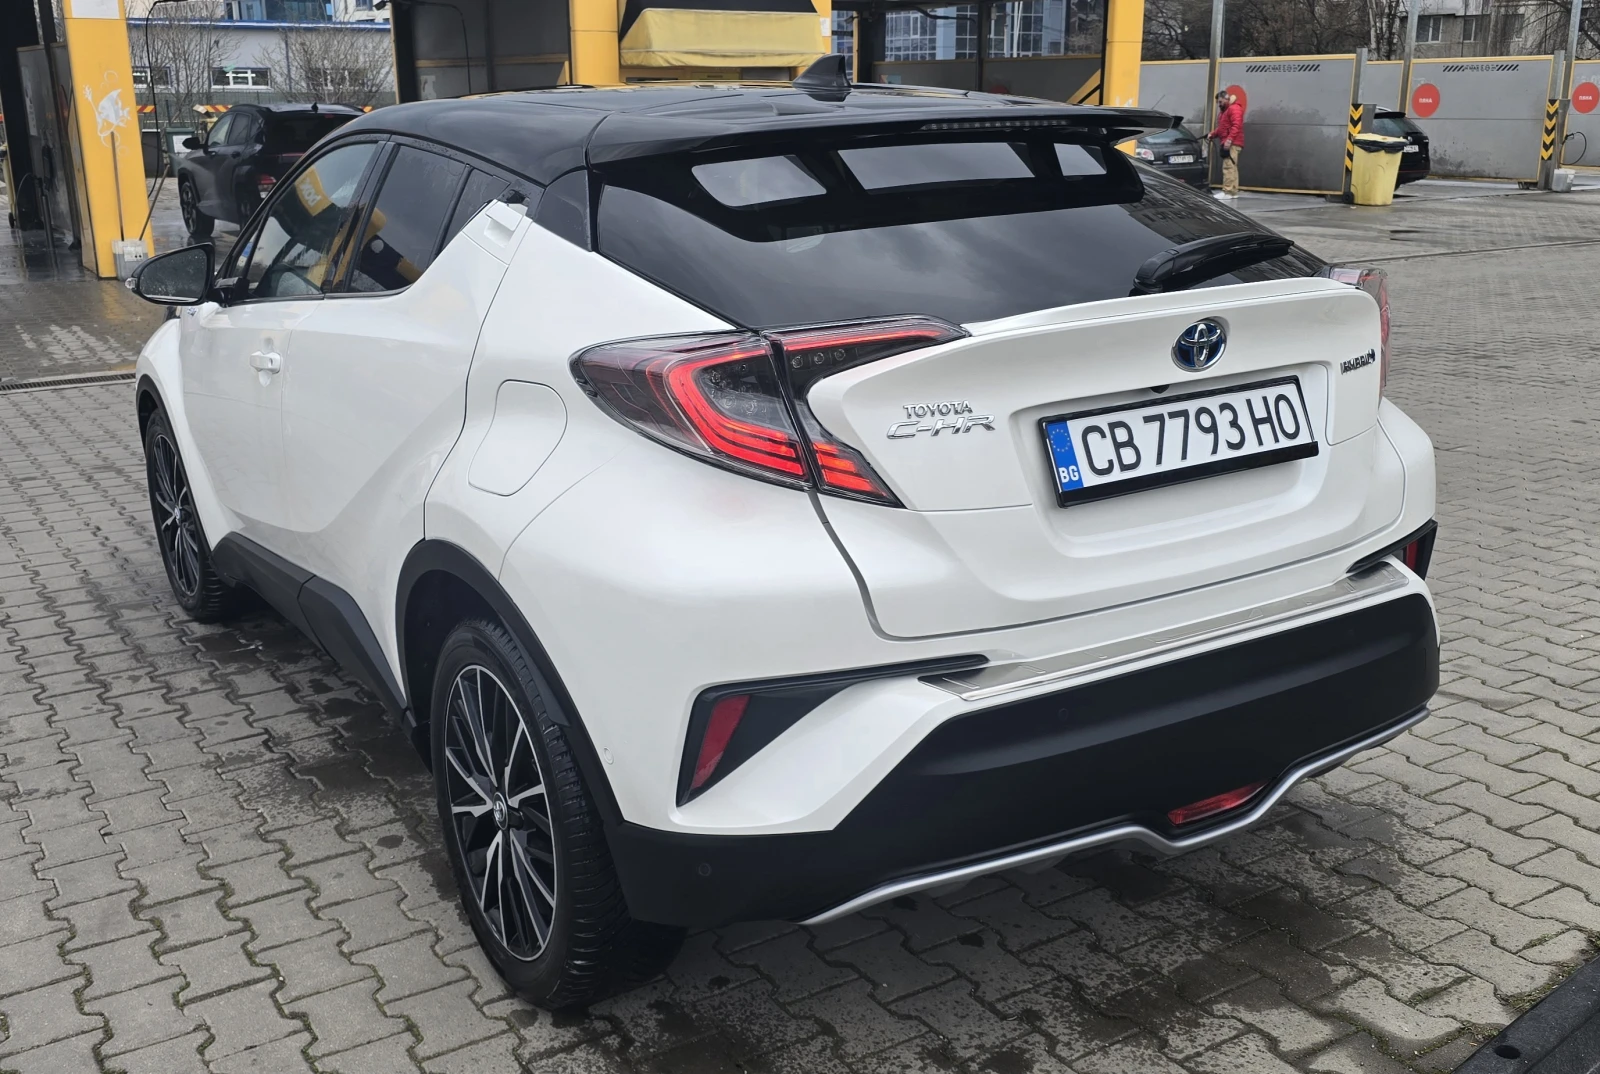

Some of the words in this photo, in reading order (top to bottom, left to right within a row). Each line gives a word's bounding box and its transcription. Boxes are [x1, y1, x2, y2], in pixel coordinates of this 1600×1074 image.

[903, 400, 973, 419] TOYOTA
[886, 414, 996, 440] C-HR
[1081, 420, 1142, 477] CB
[1142, 402, 1246, 466] 7793
[1246, 393, 1301, 447] HO
[1058, 465, 1079, 483] BG
